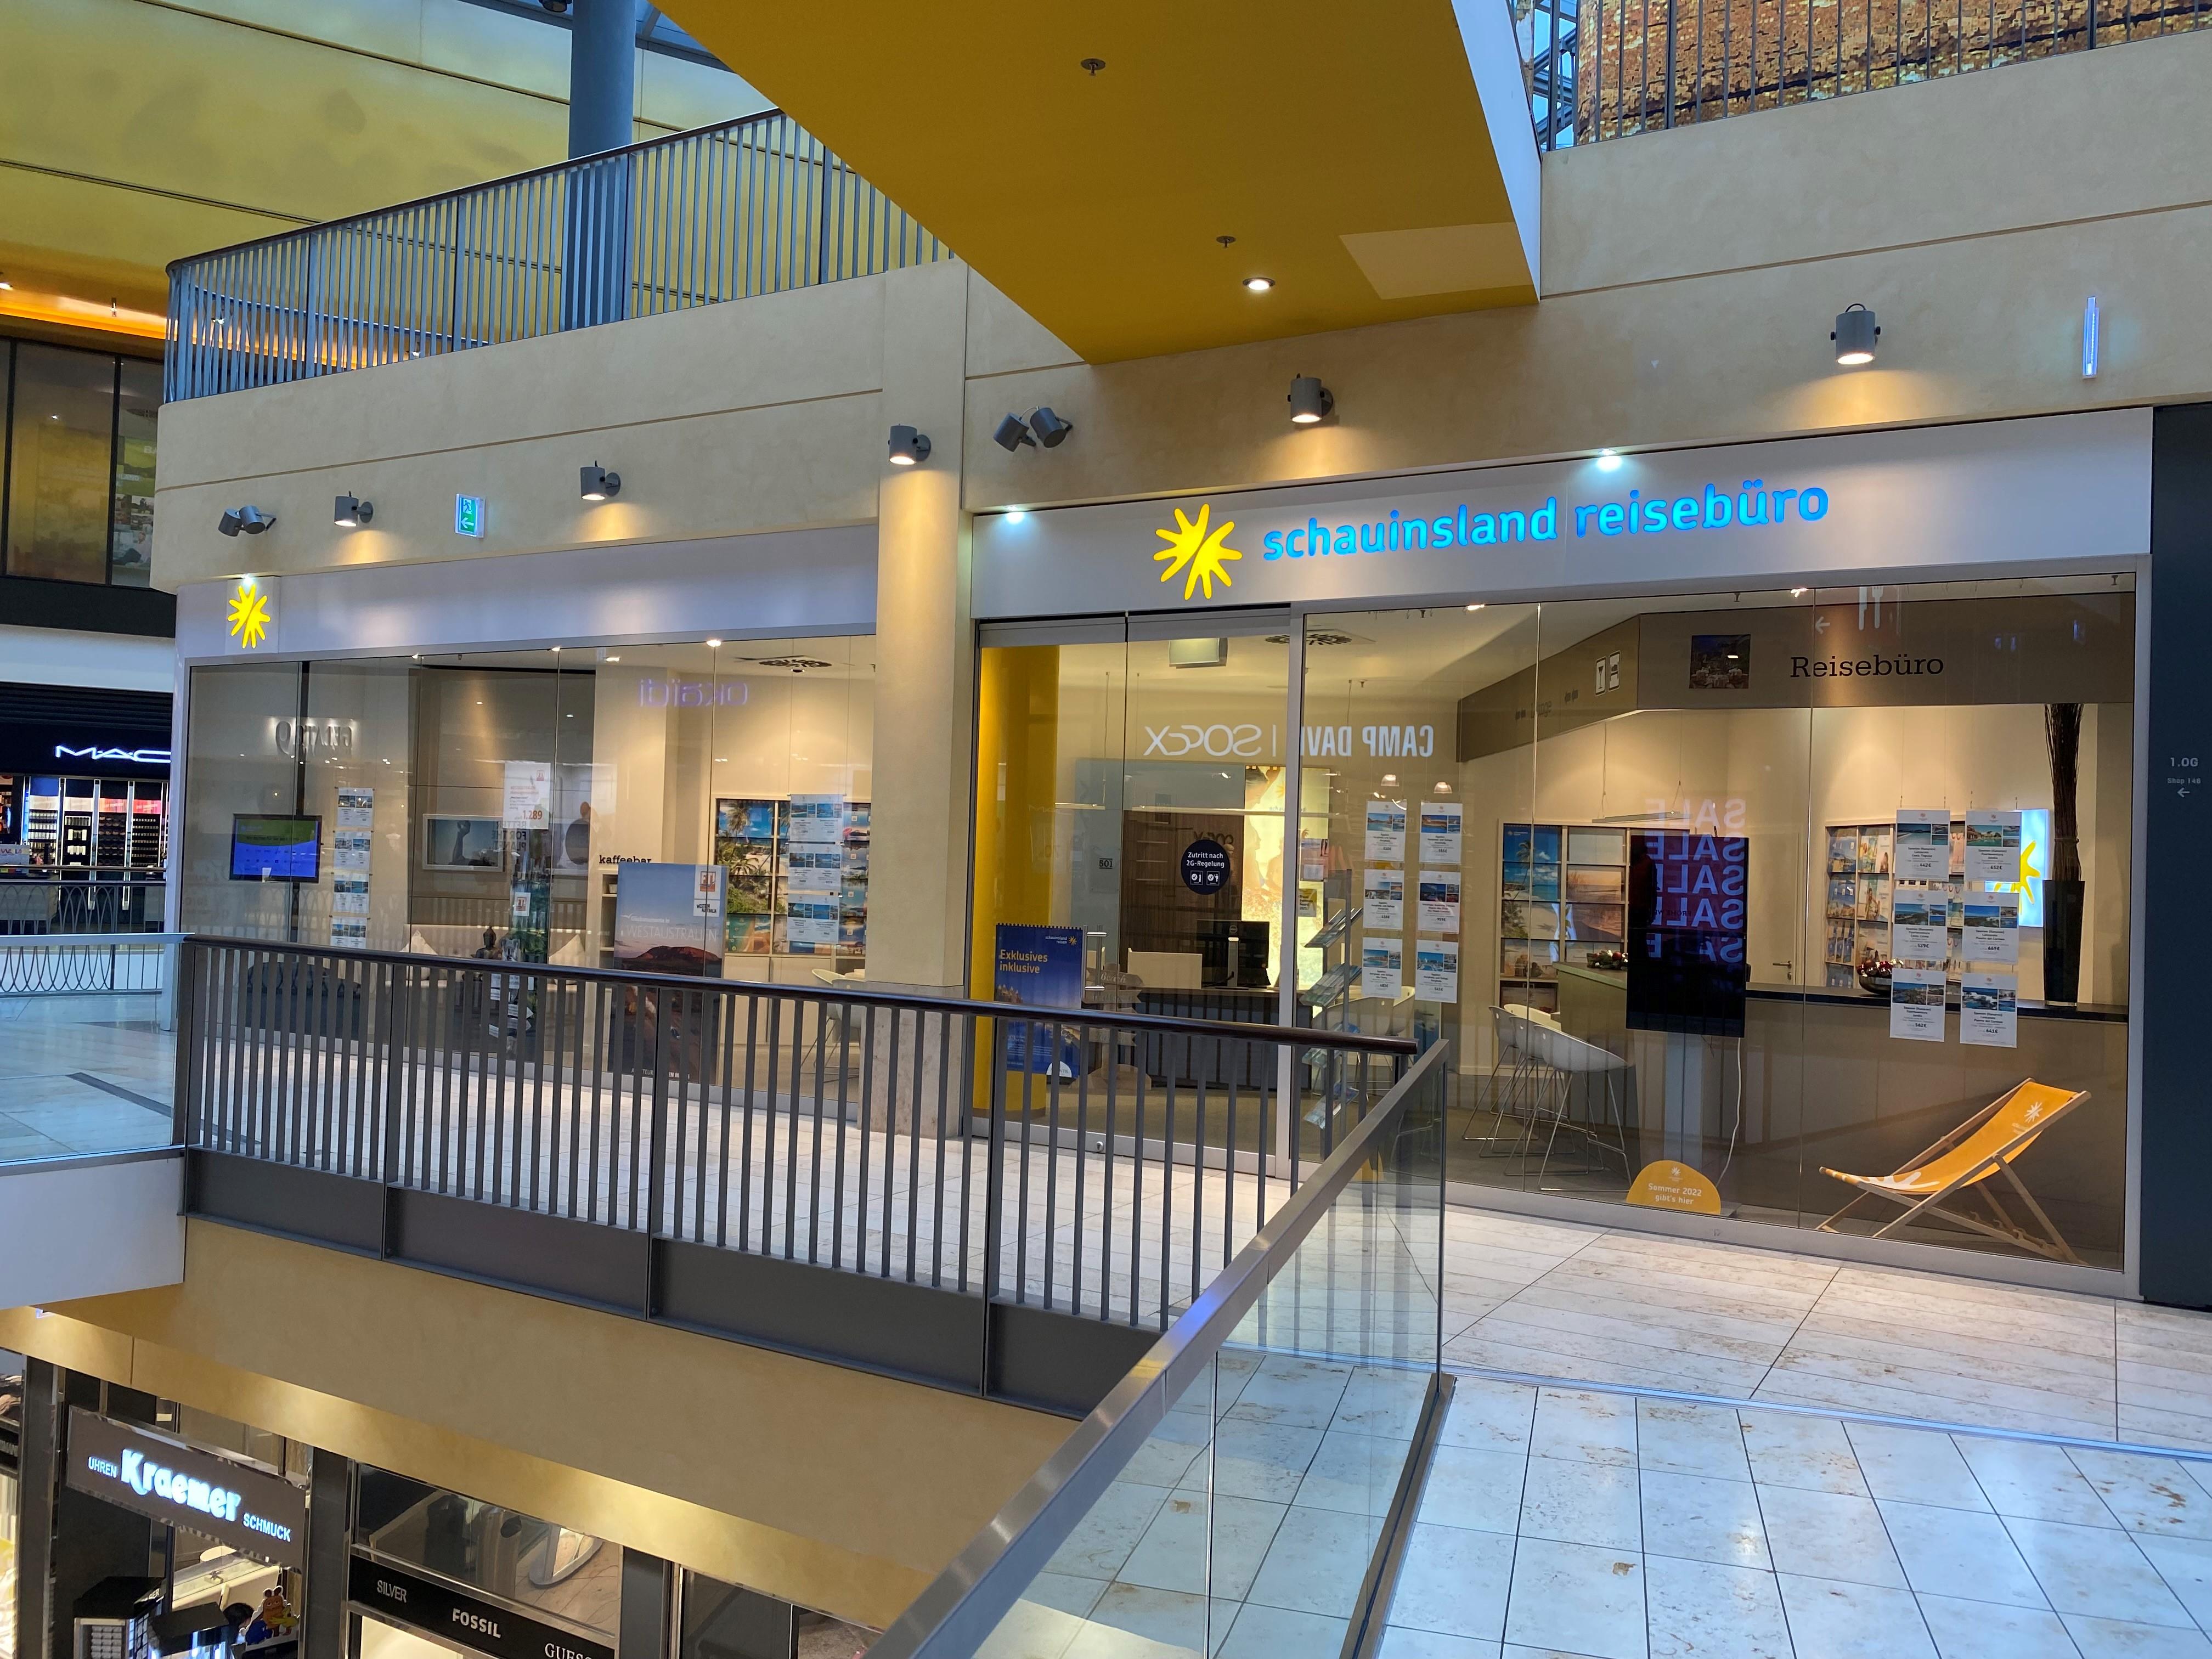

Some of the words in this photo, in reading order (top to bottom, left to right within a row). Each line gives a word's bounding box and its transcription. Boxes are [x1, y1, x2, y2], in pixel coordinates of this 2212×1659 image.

[1262, 495, 1559, 561] schauinsland
[1575, 479, 1830, 539] reisebüro
[1790, 654, 1944, 678] Reisebüro
[523, 810, 543, 820] 1.289
[599, 854, 652, 864] kaffeebar
[1186, 860, 1225, 868] 2G-Regelung
[627, 925, 717, 941] WESTAUSTRALIEN
[1000, 949, 1048, 963] Exklusives
[1000, 961, 1040, 974] inklusive
[1648, 1183, 1680, 1194] Sommer
[1683, 1187, 1702, 1197] 2022
[1655, 1194, 1676, 1203] gibt's
[1678, 1197, 1694, 1205] hier
[88, 1456, 117, 1479] UHREN
[121, 1448, 241, 1522] Kraemer
[242, 1513, 291, 1542] SCHMUCK
[376, 1579, 407, 1603] SILVER
[452, 1608, 501, 1639] FOSSIL
[545, 1643, 592, 1659] GUE
